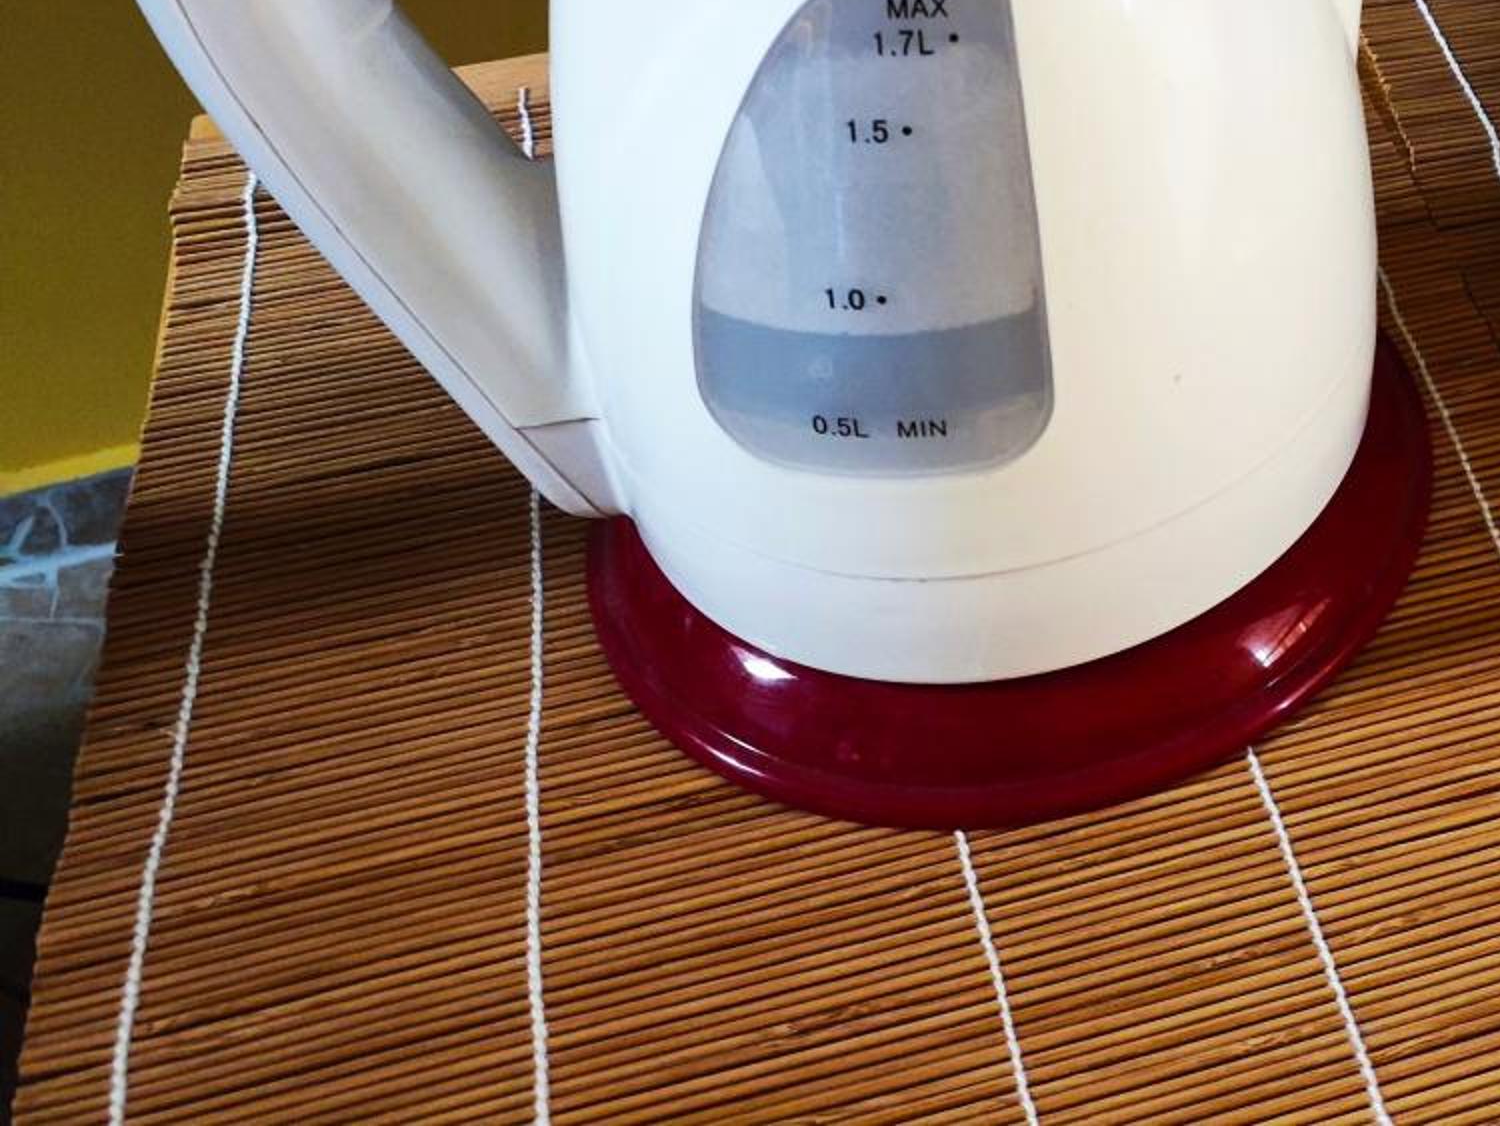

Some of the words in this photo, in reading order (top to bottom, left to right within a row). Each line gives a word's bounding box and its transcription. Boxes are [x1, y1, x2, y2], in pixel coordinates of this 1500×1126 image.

[873, 30, 934, 57] 1.7L
[846, 119, 889, 144] 1.5
[824, 288, 866, 311] 1.0
[812, 416, 868, 439] 0.5L
[896, 420, 947, 438] MIN
